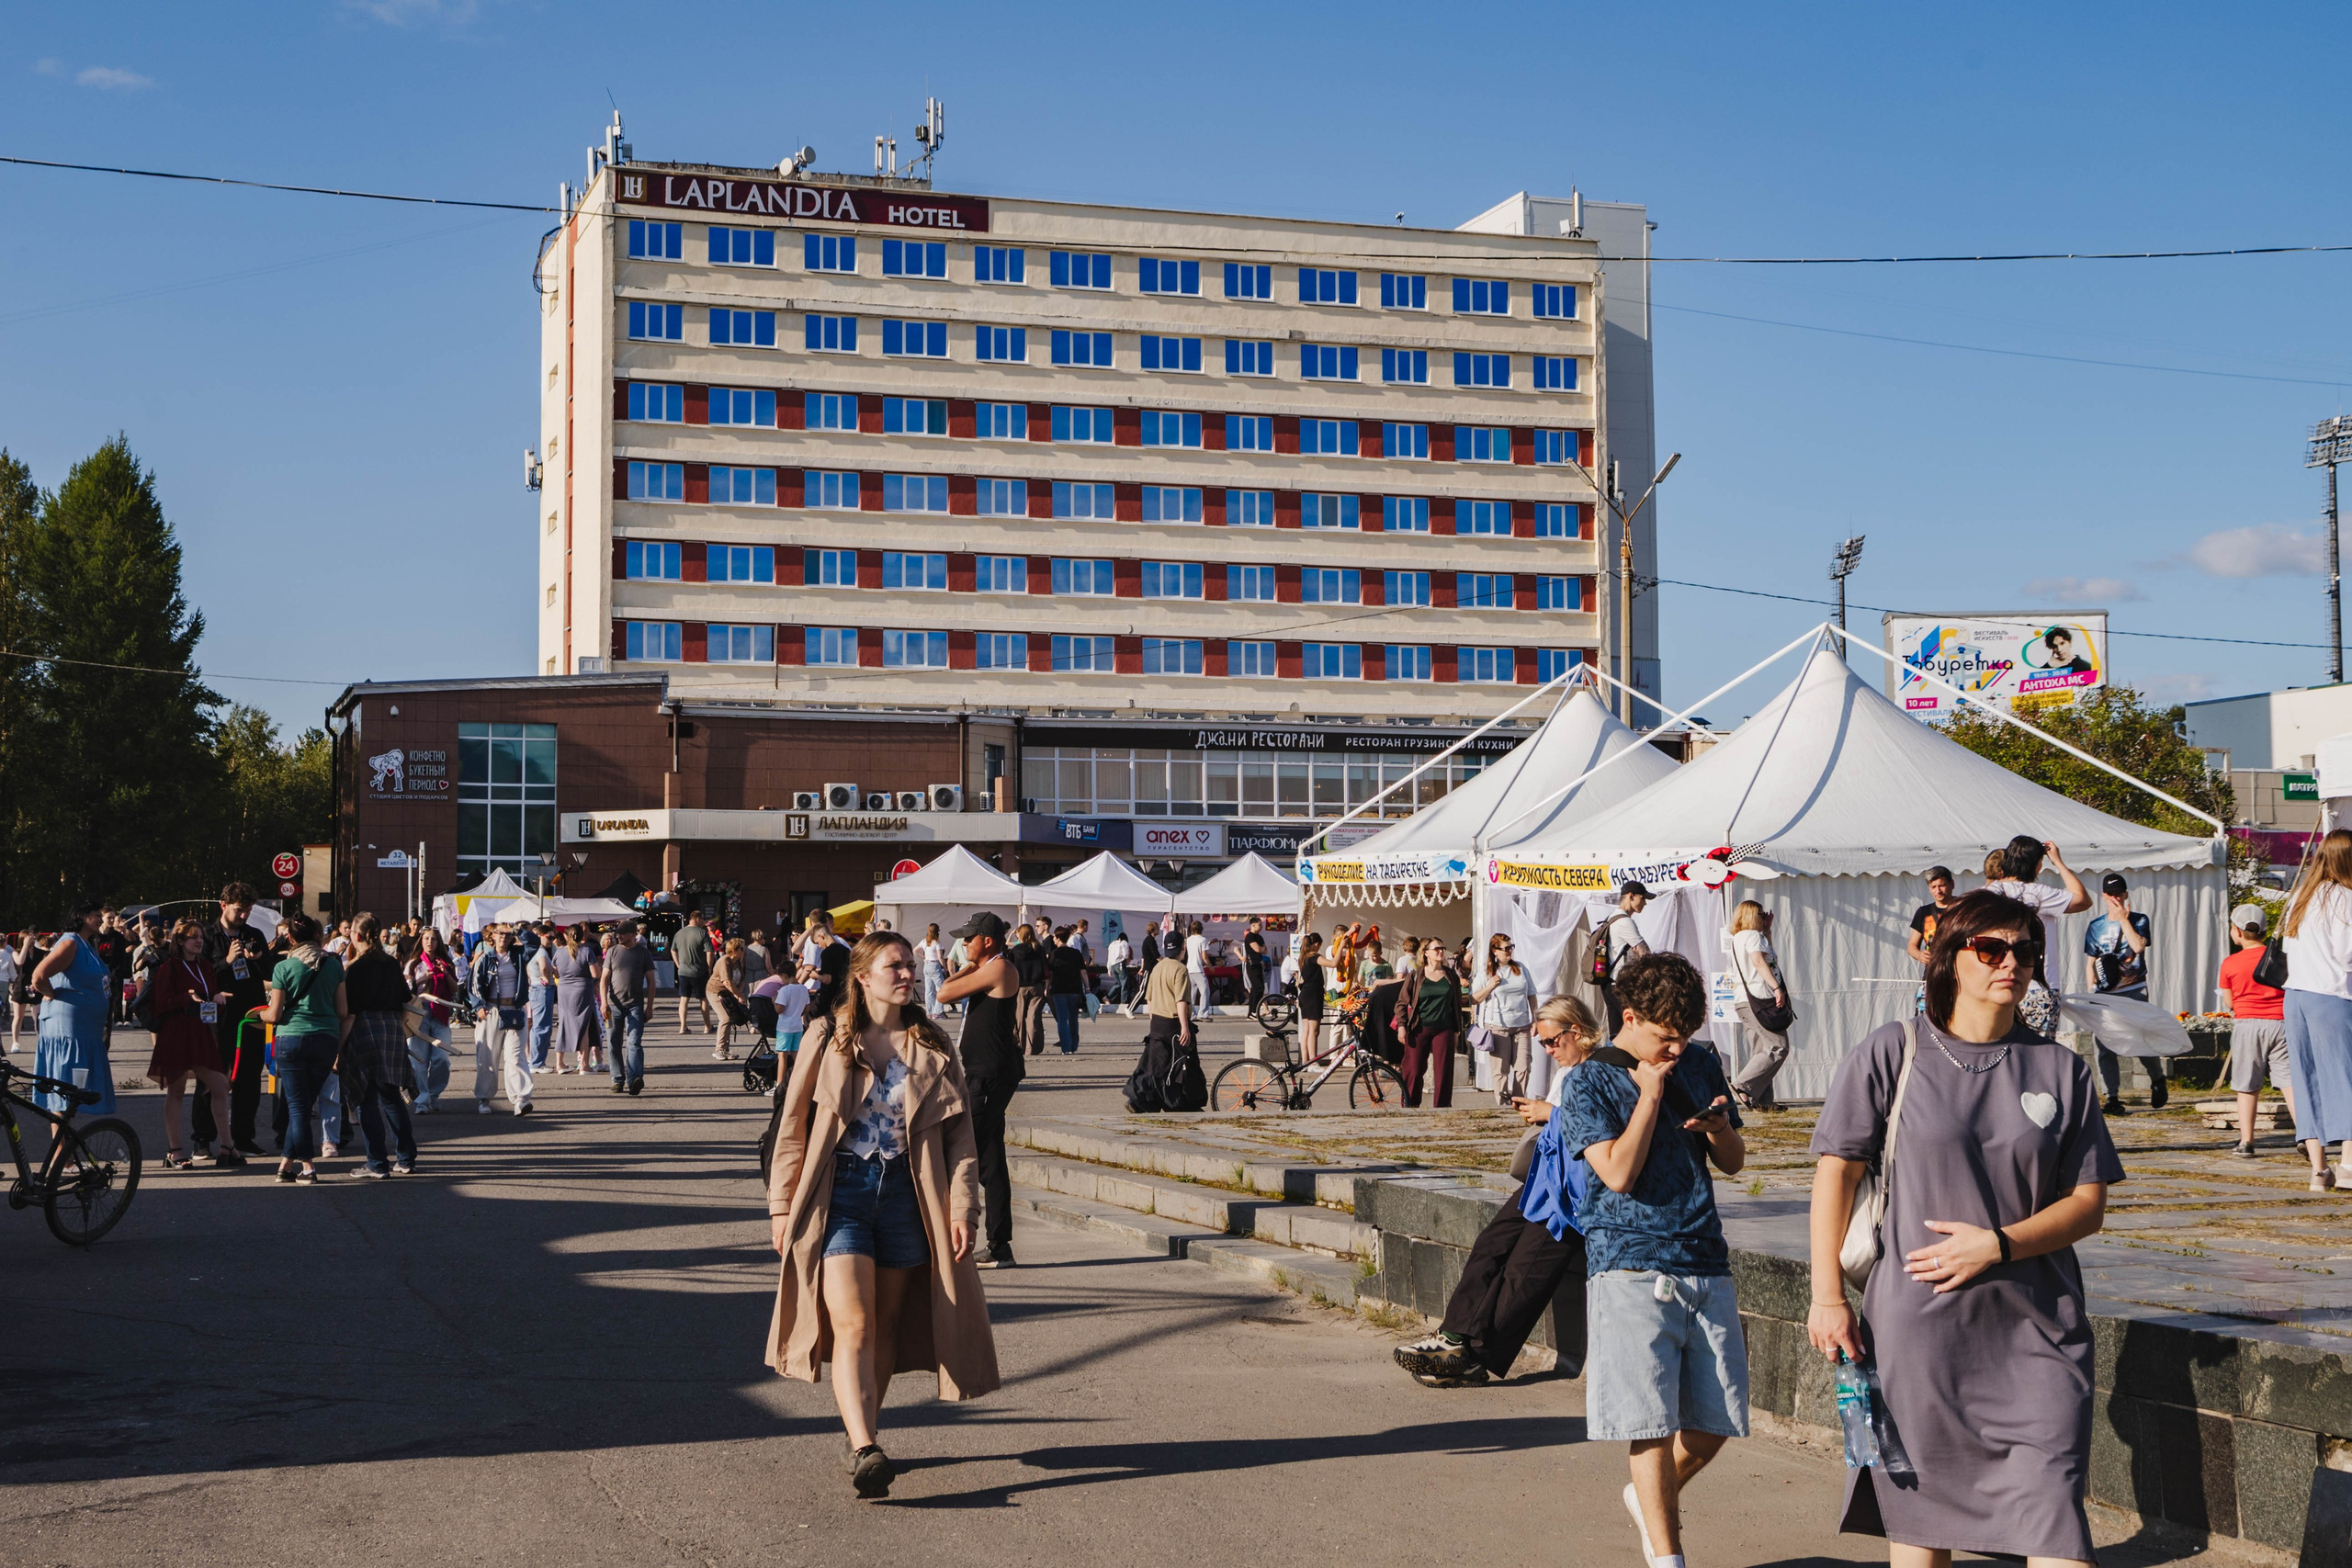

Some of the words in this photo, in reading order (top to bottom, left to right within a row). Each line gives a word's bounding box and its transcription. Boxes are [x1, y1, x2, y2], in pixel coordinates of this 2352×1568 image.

[664, 176, 860, 220] LAPLANDIA
[888, 205, 966, 228] HOTEL
[2023, 678, 2066, 691] АНТОХА
[2067, 674, 2086, 684] МС
[1345, 737, 1401, 748] РЕСТОРАН
[1477, 739, 1514, 750] КУХНИ
[409, 750, 446, 761] КОНФЕТНО
[409, 763, 446, 776] БУКЕТНЫЙ
[409, 779, 436, 791] ПЕРИОД
[596, 819, 650, 830] LAPLANDIA
[816, 816, 908, 830] ЛАПЛАНДИЯ
[1066, 823, 1081, 839] ВТБ
[1146, 830, 1190, 844] anex
[278, 861, 294, 872] 24
[1317, 864, 1363, 882] РУКОДЕЛИЕ
[1365, 864, 1378, 880] НА
[1379, 862, 1430, 879] ТАБУРЕТКЕ
[1563, 867, 1606, 886] СЕВЕРА
[1611, 868, 1628, 886] НА
[1627, 860, 1698, 884] ТАБУРЕ
